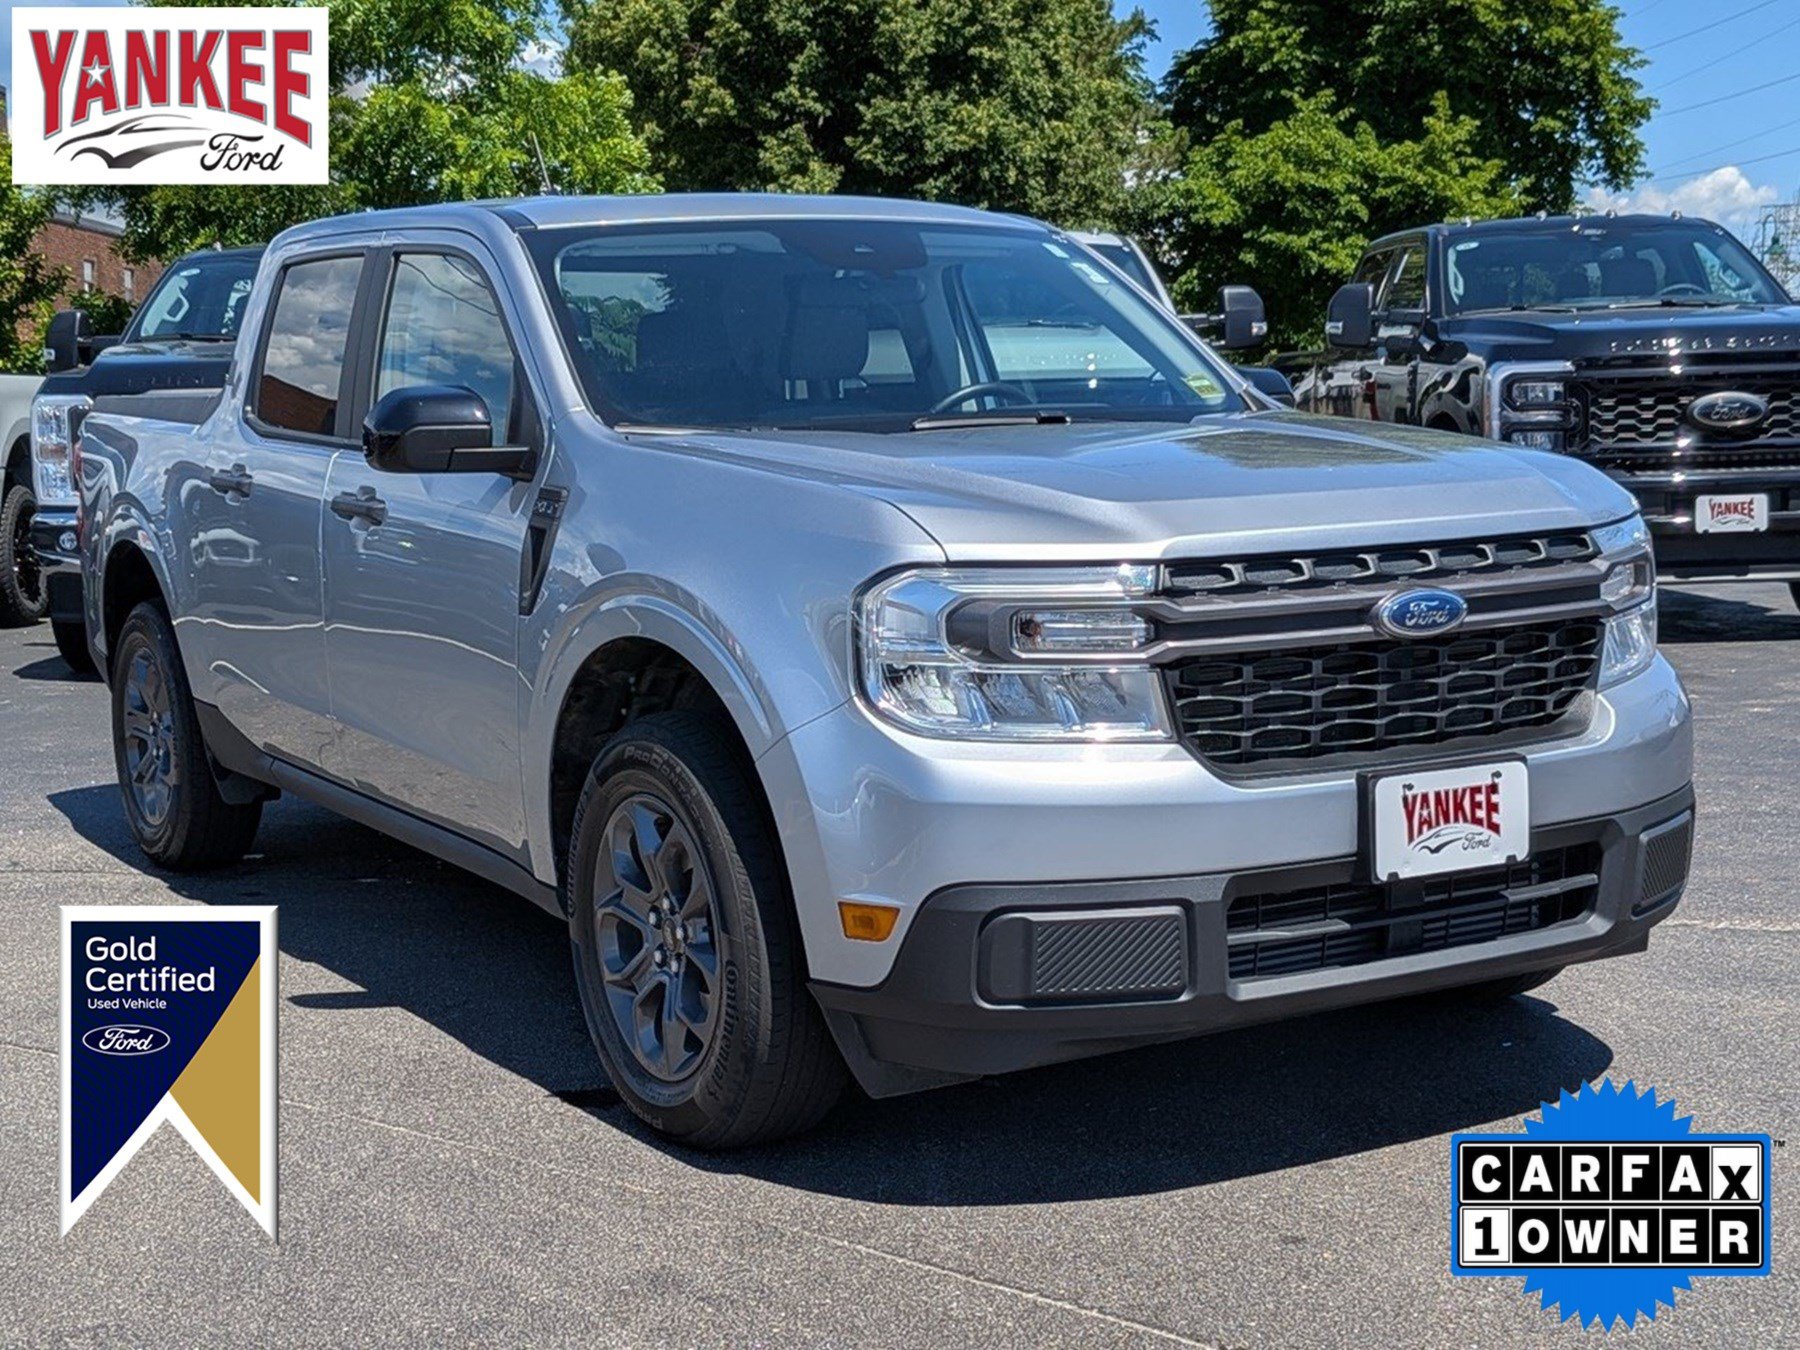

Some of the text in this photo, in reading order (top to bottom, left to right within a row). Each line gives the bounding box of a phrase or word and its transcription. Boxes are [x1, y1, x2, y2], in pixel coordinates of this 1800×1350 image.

[1709, 500, 1755, 520] YANKEE
[1405, 600, 1450, 627] Ford
[1402, 782, 1501, 846] YANKEE
[1461, 831, 1491, 850] Ford
